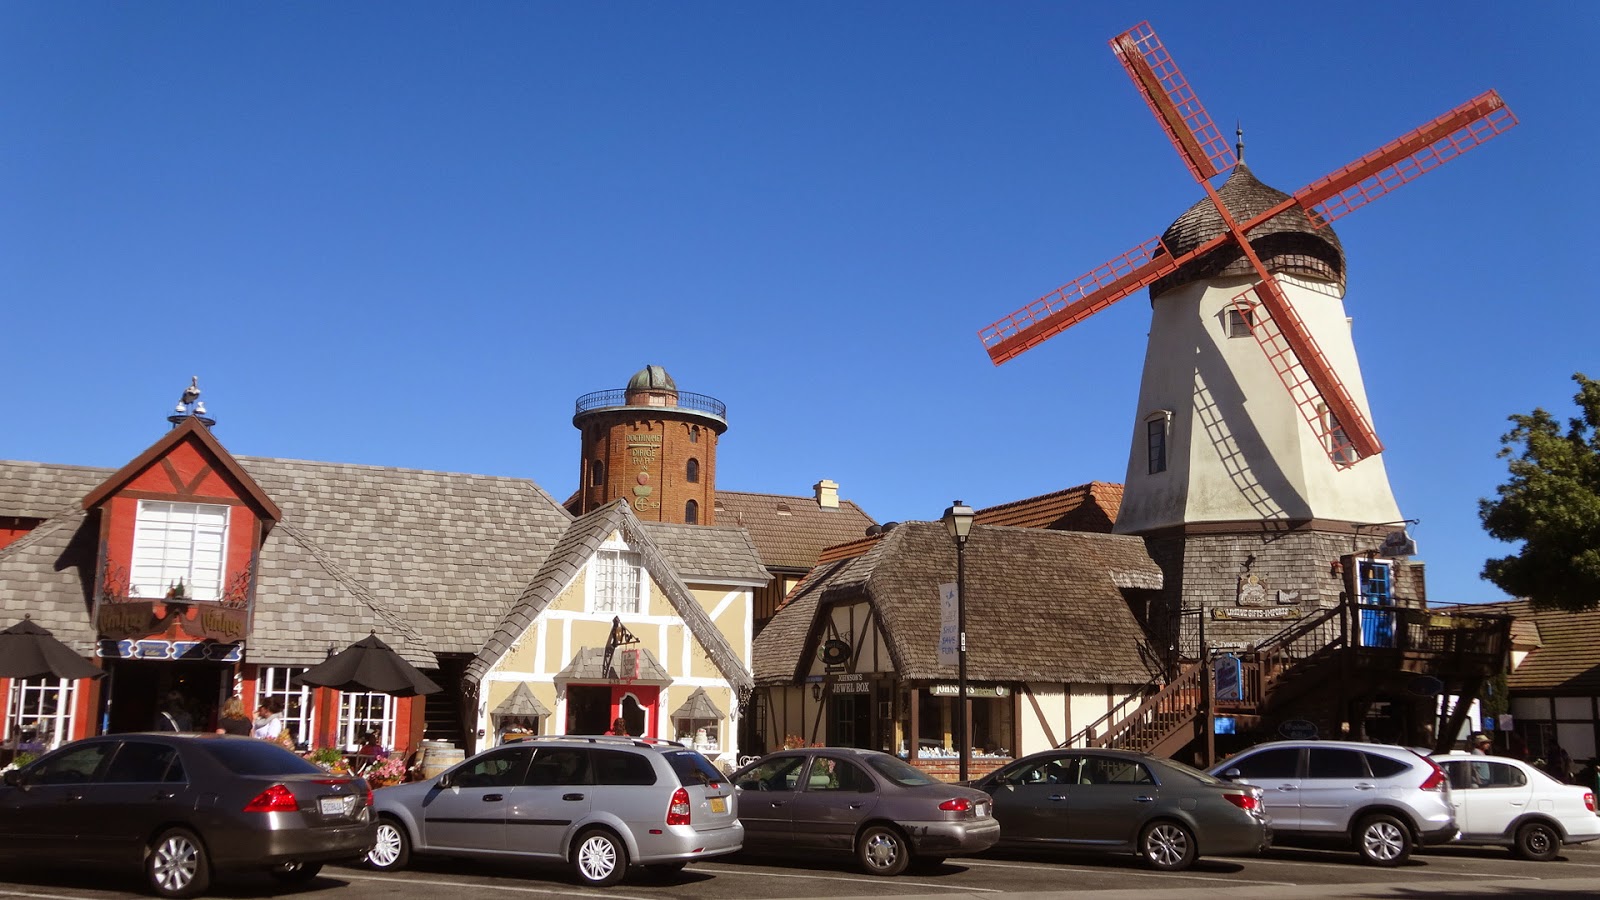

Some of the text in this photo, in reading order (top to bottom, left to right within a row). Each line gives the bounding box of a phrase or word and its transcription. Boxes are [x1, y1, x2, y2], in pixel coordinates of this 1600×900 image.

[632, 449, 656, 457] DIRIGE
[838, 674, 863, 682] JOHNSON'S
[832, 682, 870, 693] JEWEL BOX
